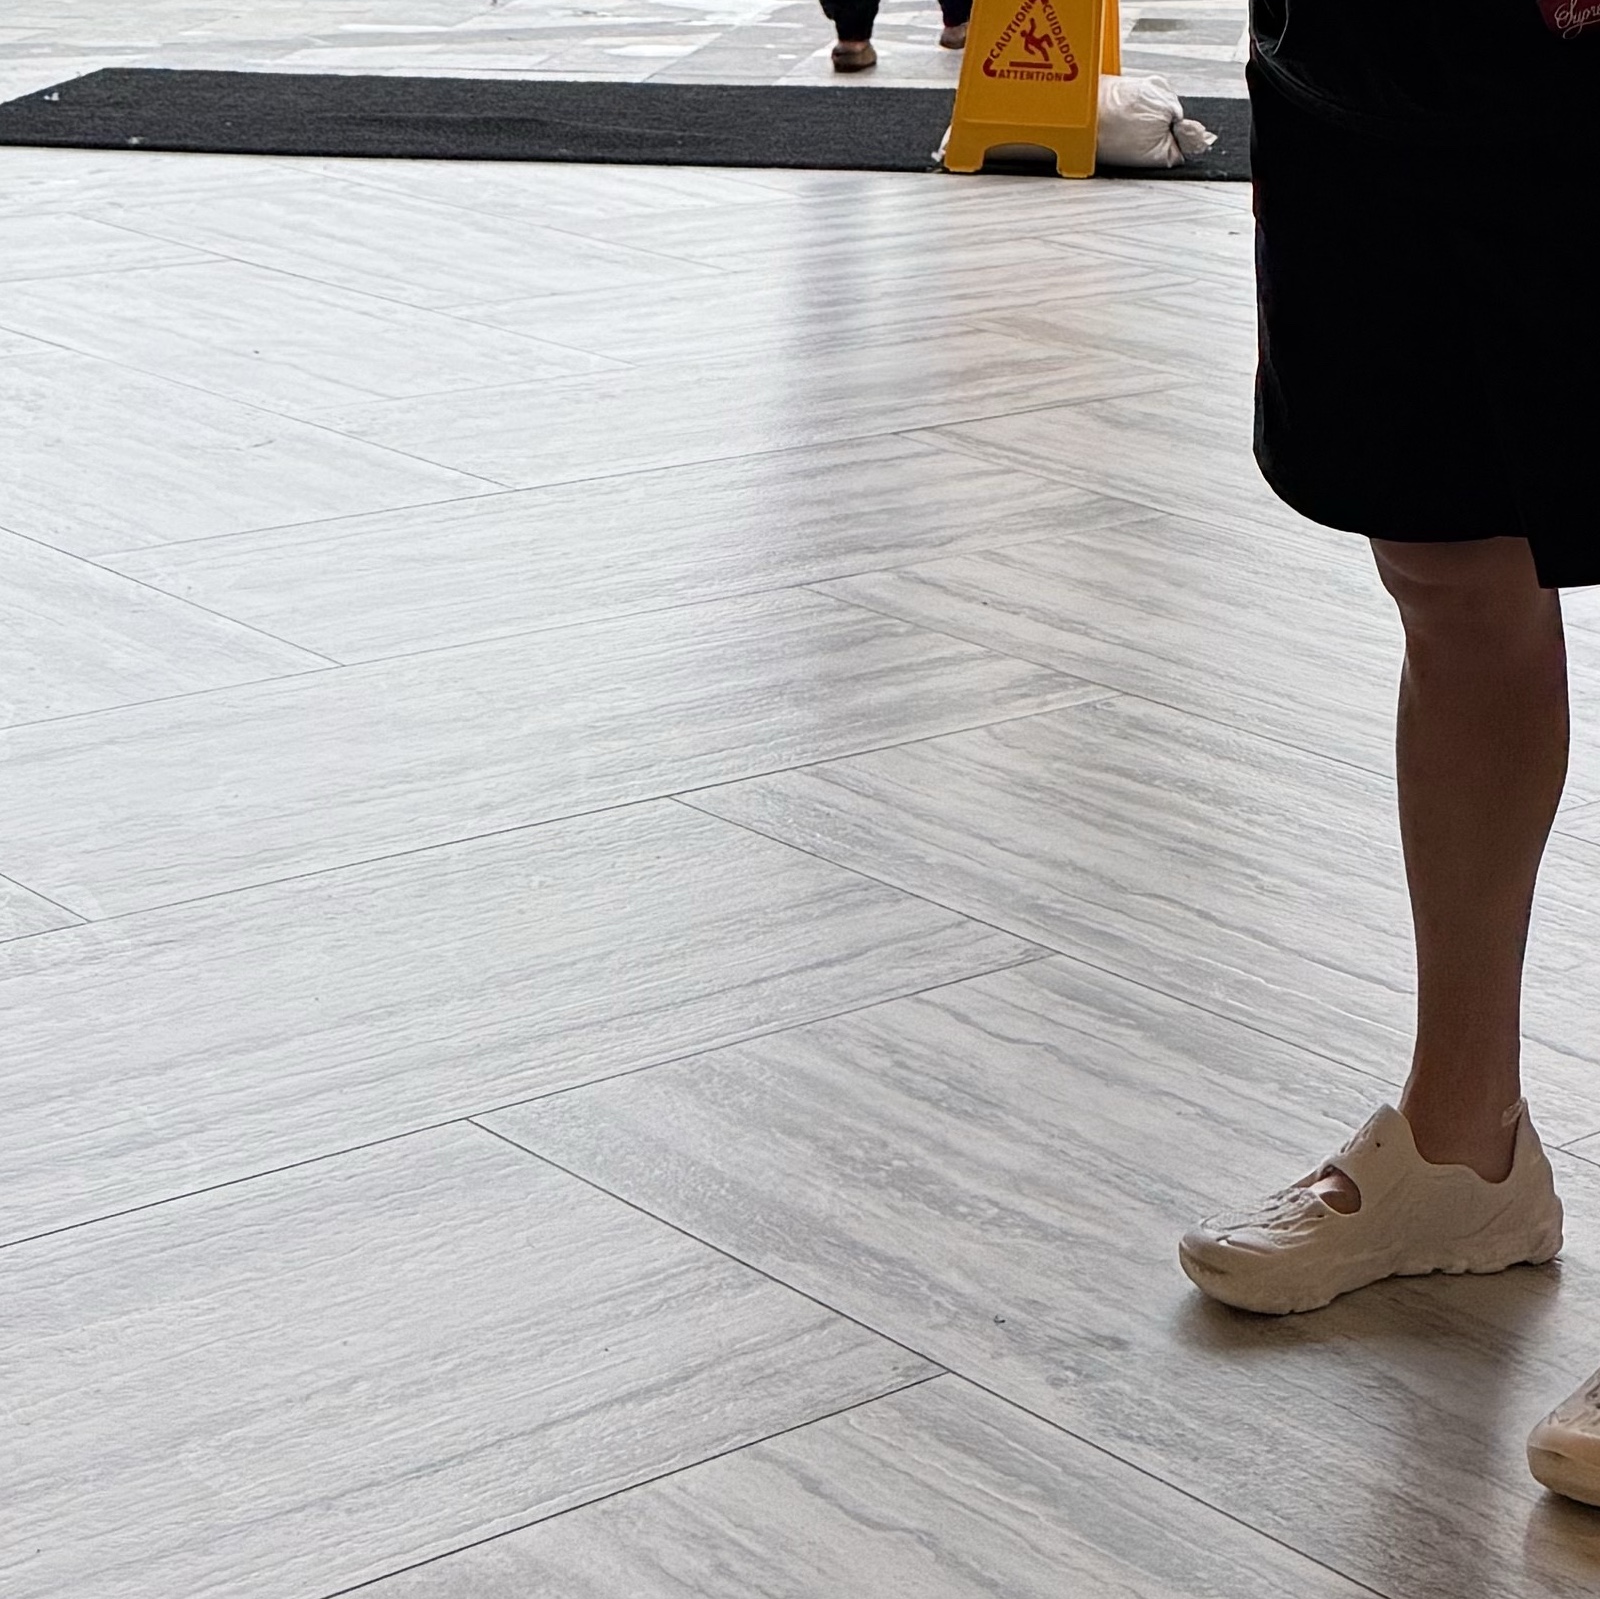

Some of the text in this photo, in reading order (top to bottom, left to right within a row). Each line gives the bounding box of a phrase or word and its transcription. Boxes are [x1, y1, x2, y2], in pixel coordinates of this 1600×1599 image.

[990, 1, 1033, 59] CAUTION
[1043, 4, 1075, 64] CUIDADO
[998, 69, 1063, 81] ATTENTION
